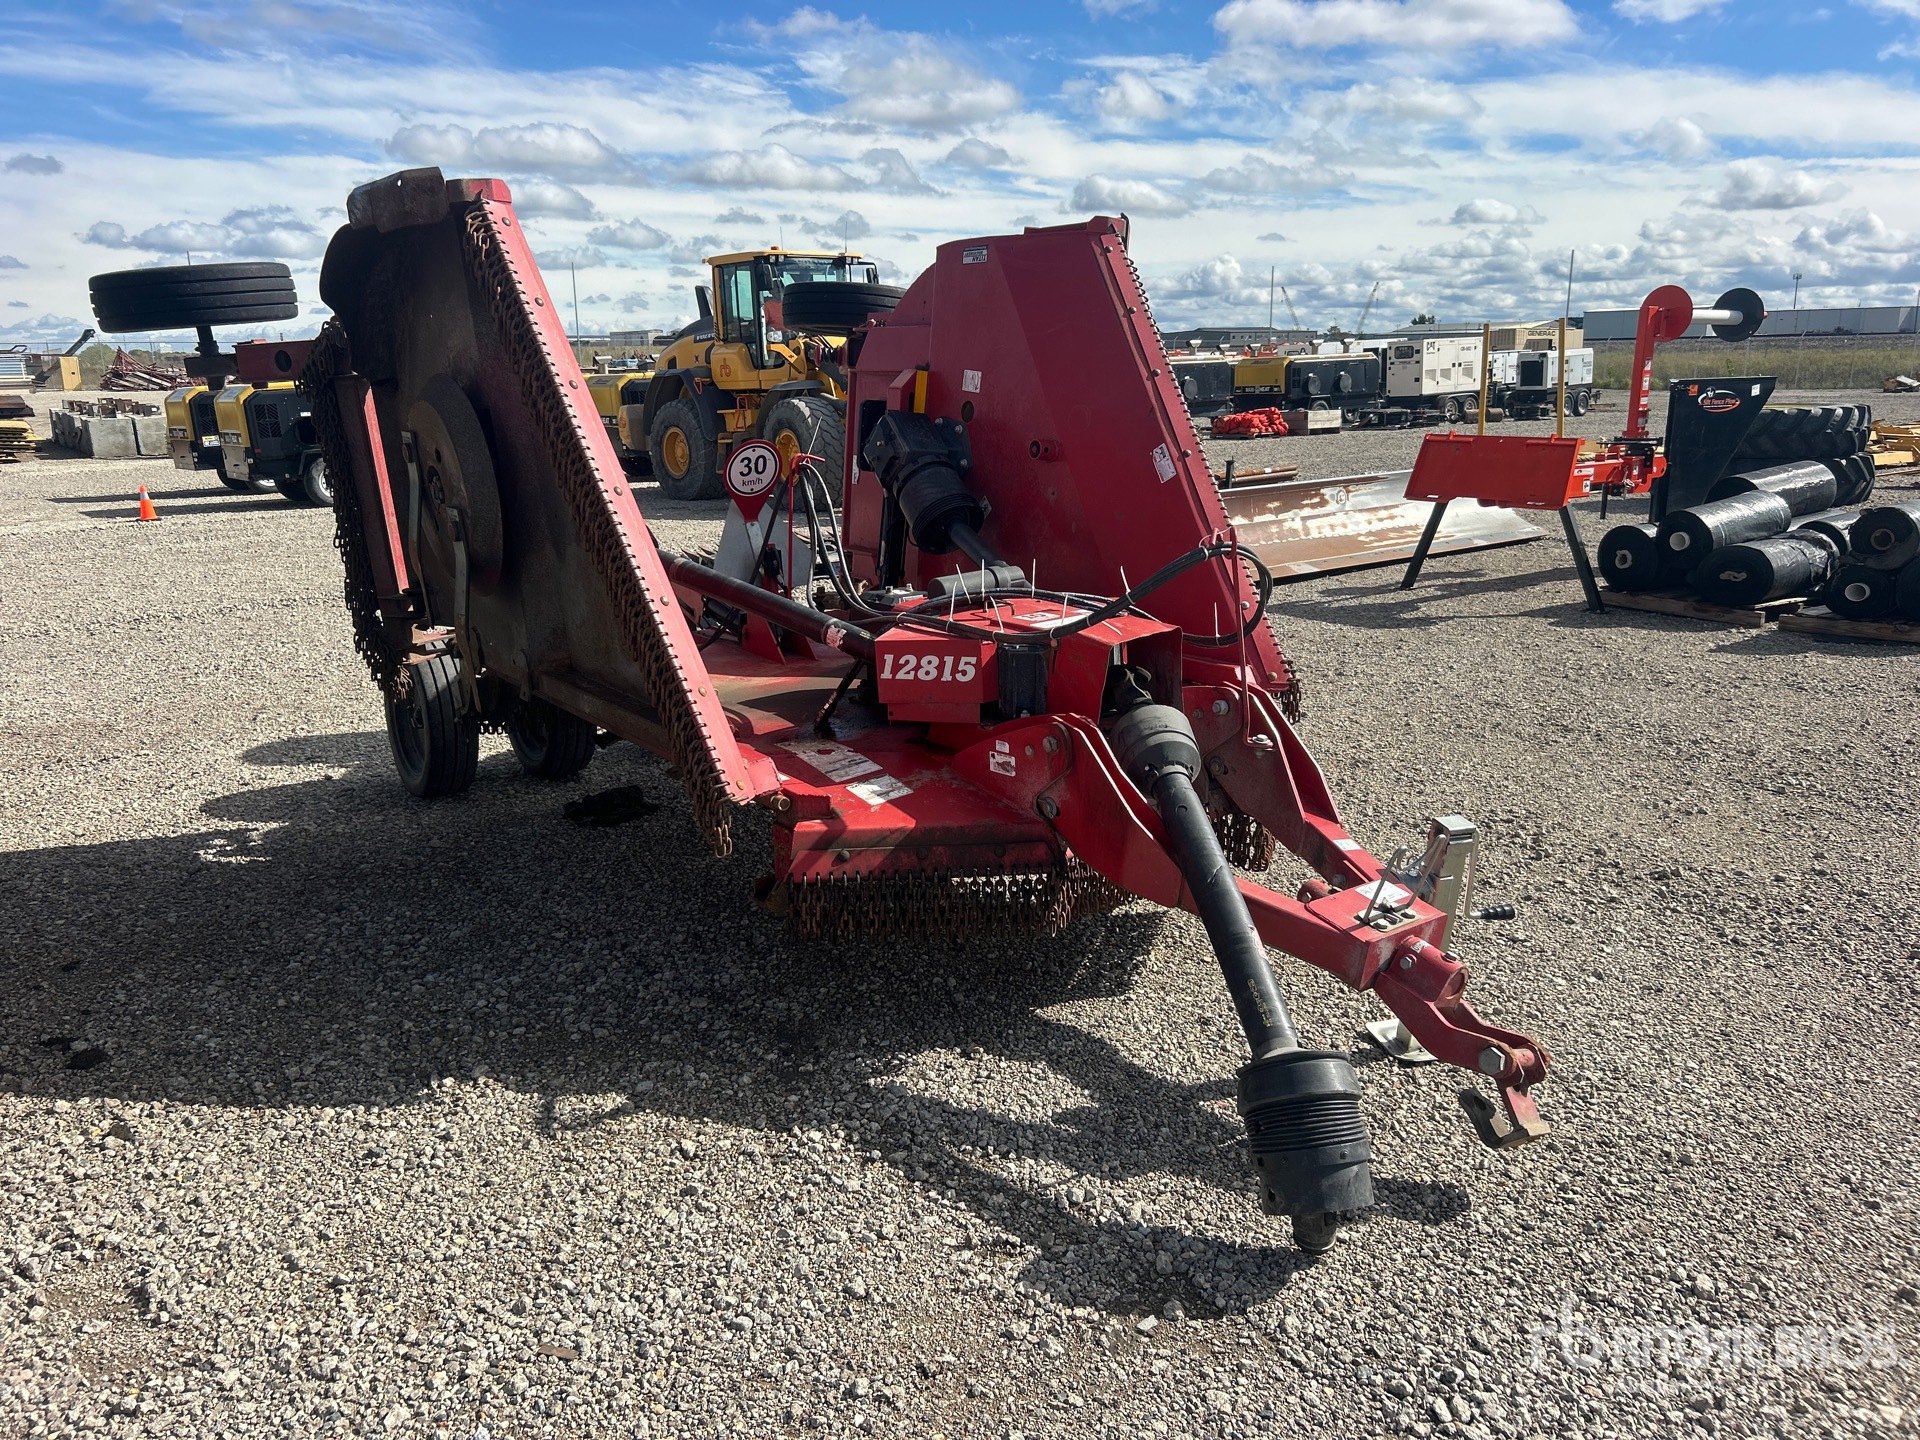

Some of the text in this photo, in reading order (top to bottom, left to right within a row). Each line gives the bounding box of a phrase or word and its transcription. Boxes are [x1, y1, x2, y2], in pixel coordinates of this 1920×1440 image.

[1426, 341, 1435, 351] CAT
[738, 454, 768, 477] 30
[741, 477, 763, 487] km/h
[880, 653, 978, 683] 12815
